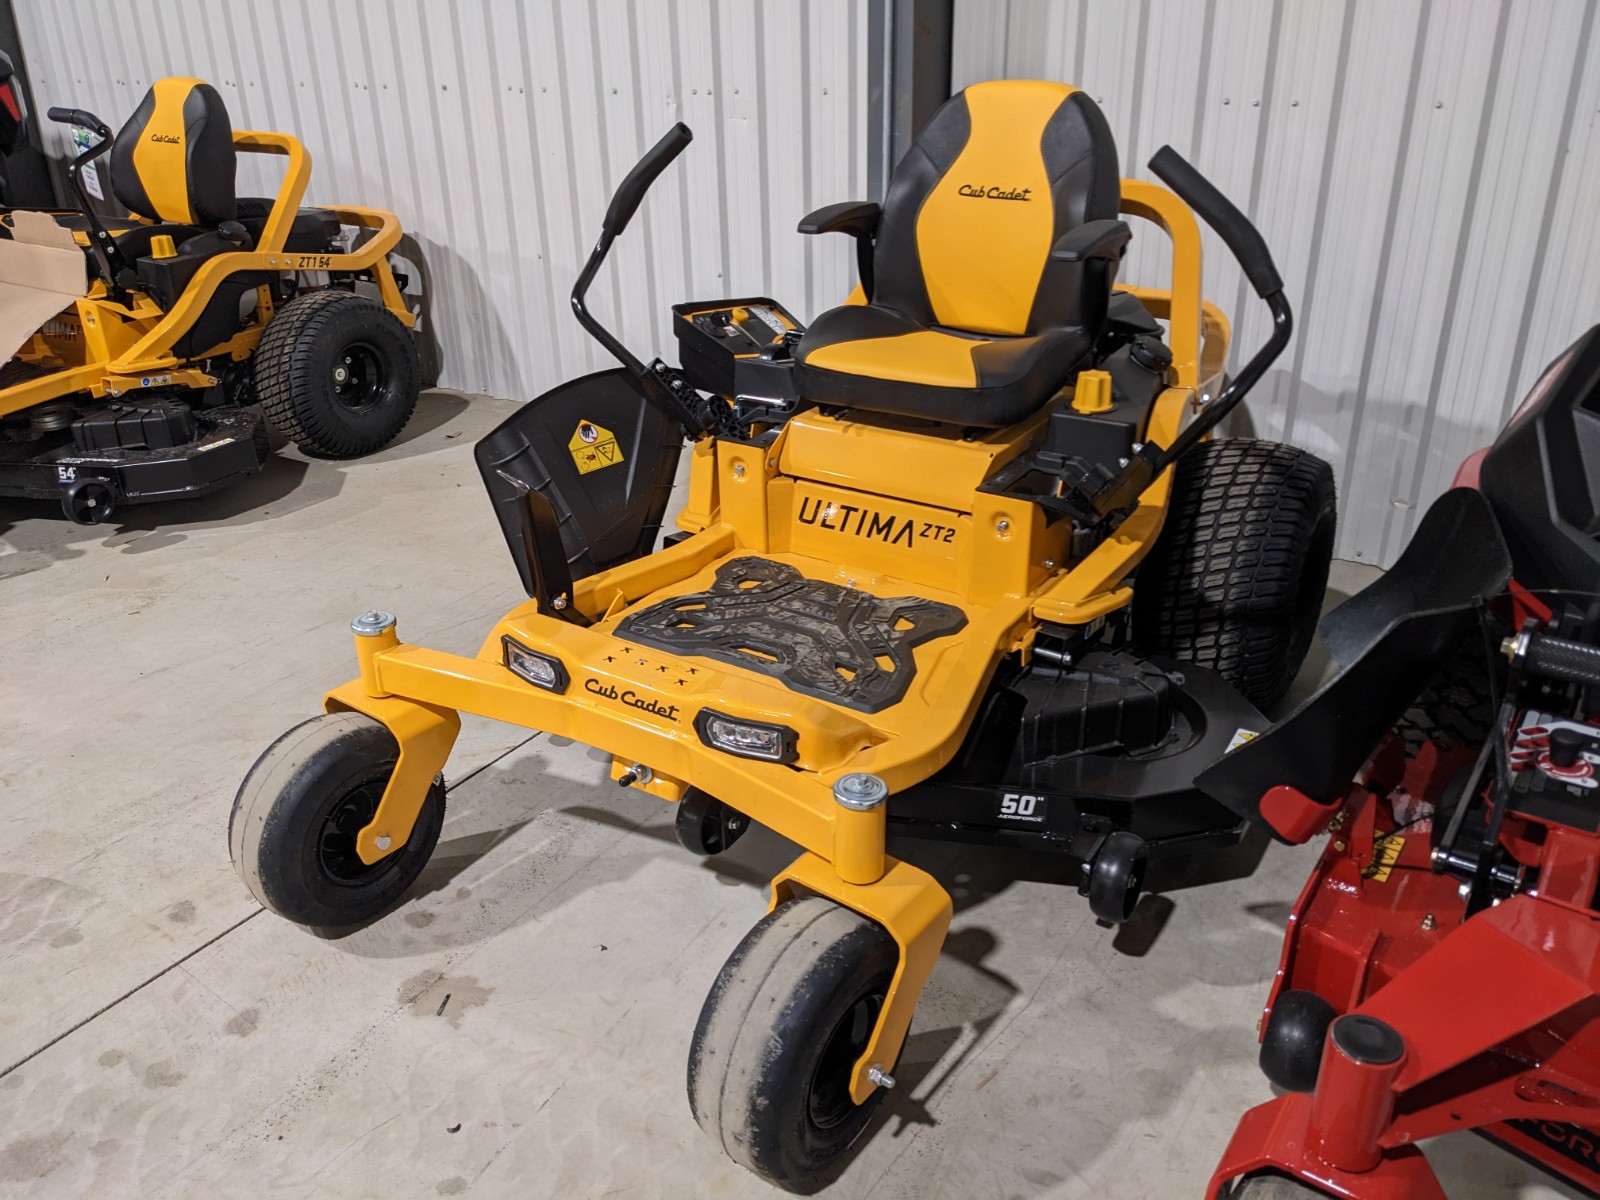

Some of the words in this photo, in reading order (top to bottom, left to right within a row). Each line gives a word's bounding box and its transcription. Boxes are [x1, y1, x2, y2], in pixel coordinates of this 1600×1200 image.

[151, 134, 163, 142] Cub
[164, 135, 180, 144] Cadet
[958, 184, 985, 198] Cub
[987, 186, 1031, 201] Cadet
[298, 256, 317, 268] ZT1
[798, 497, 914, 548] ULTIMA
[919, 522, 956, 543] ZT2
[584, 678, 618, 700] Cub
[620, 690, 680, 722] Cadet
[1000, 793, 1045, 815] 50"
[997, 813, 1046, 822] AEROFORCE
